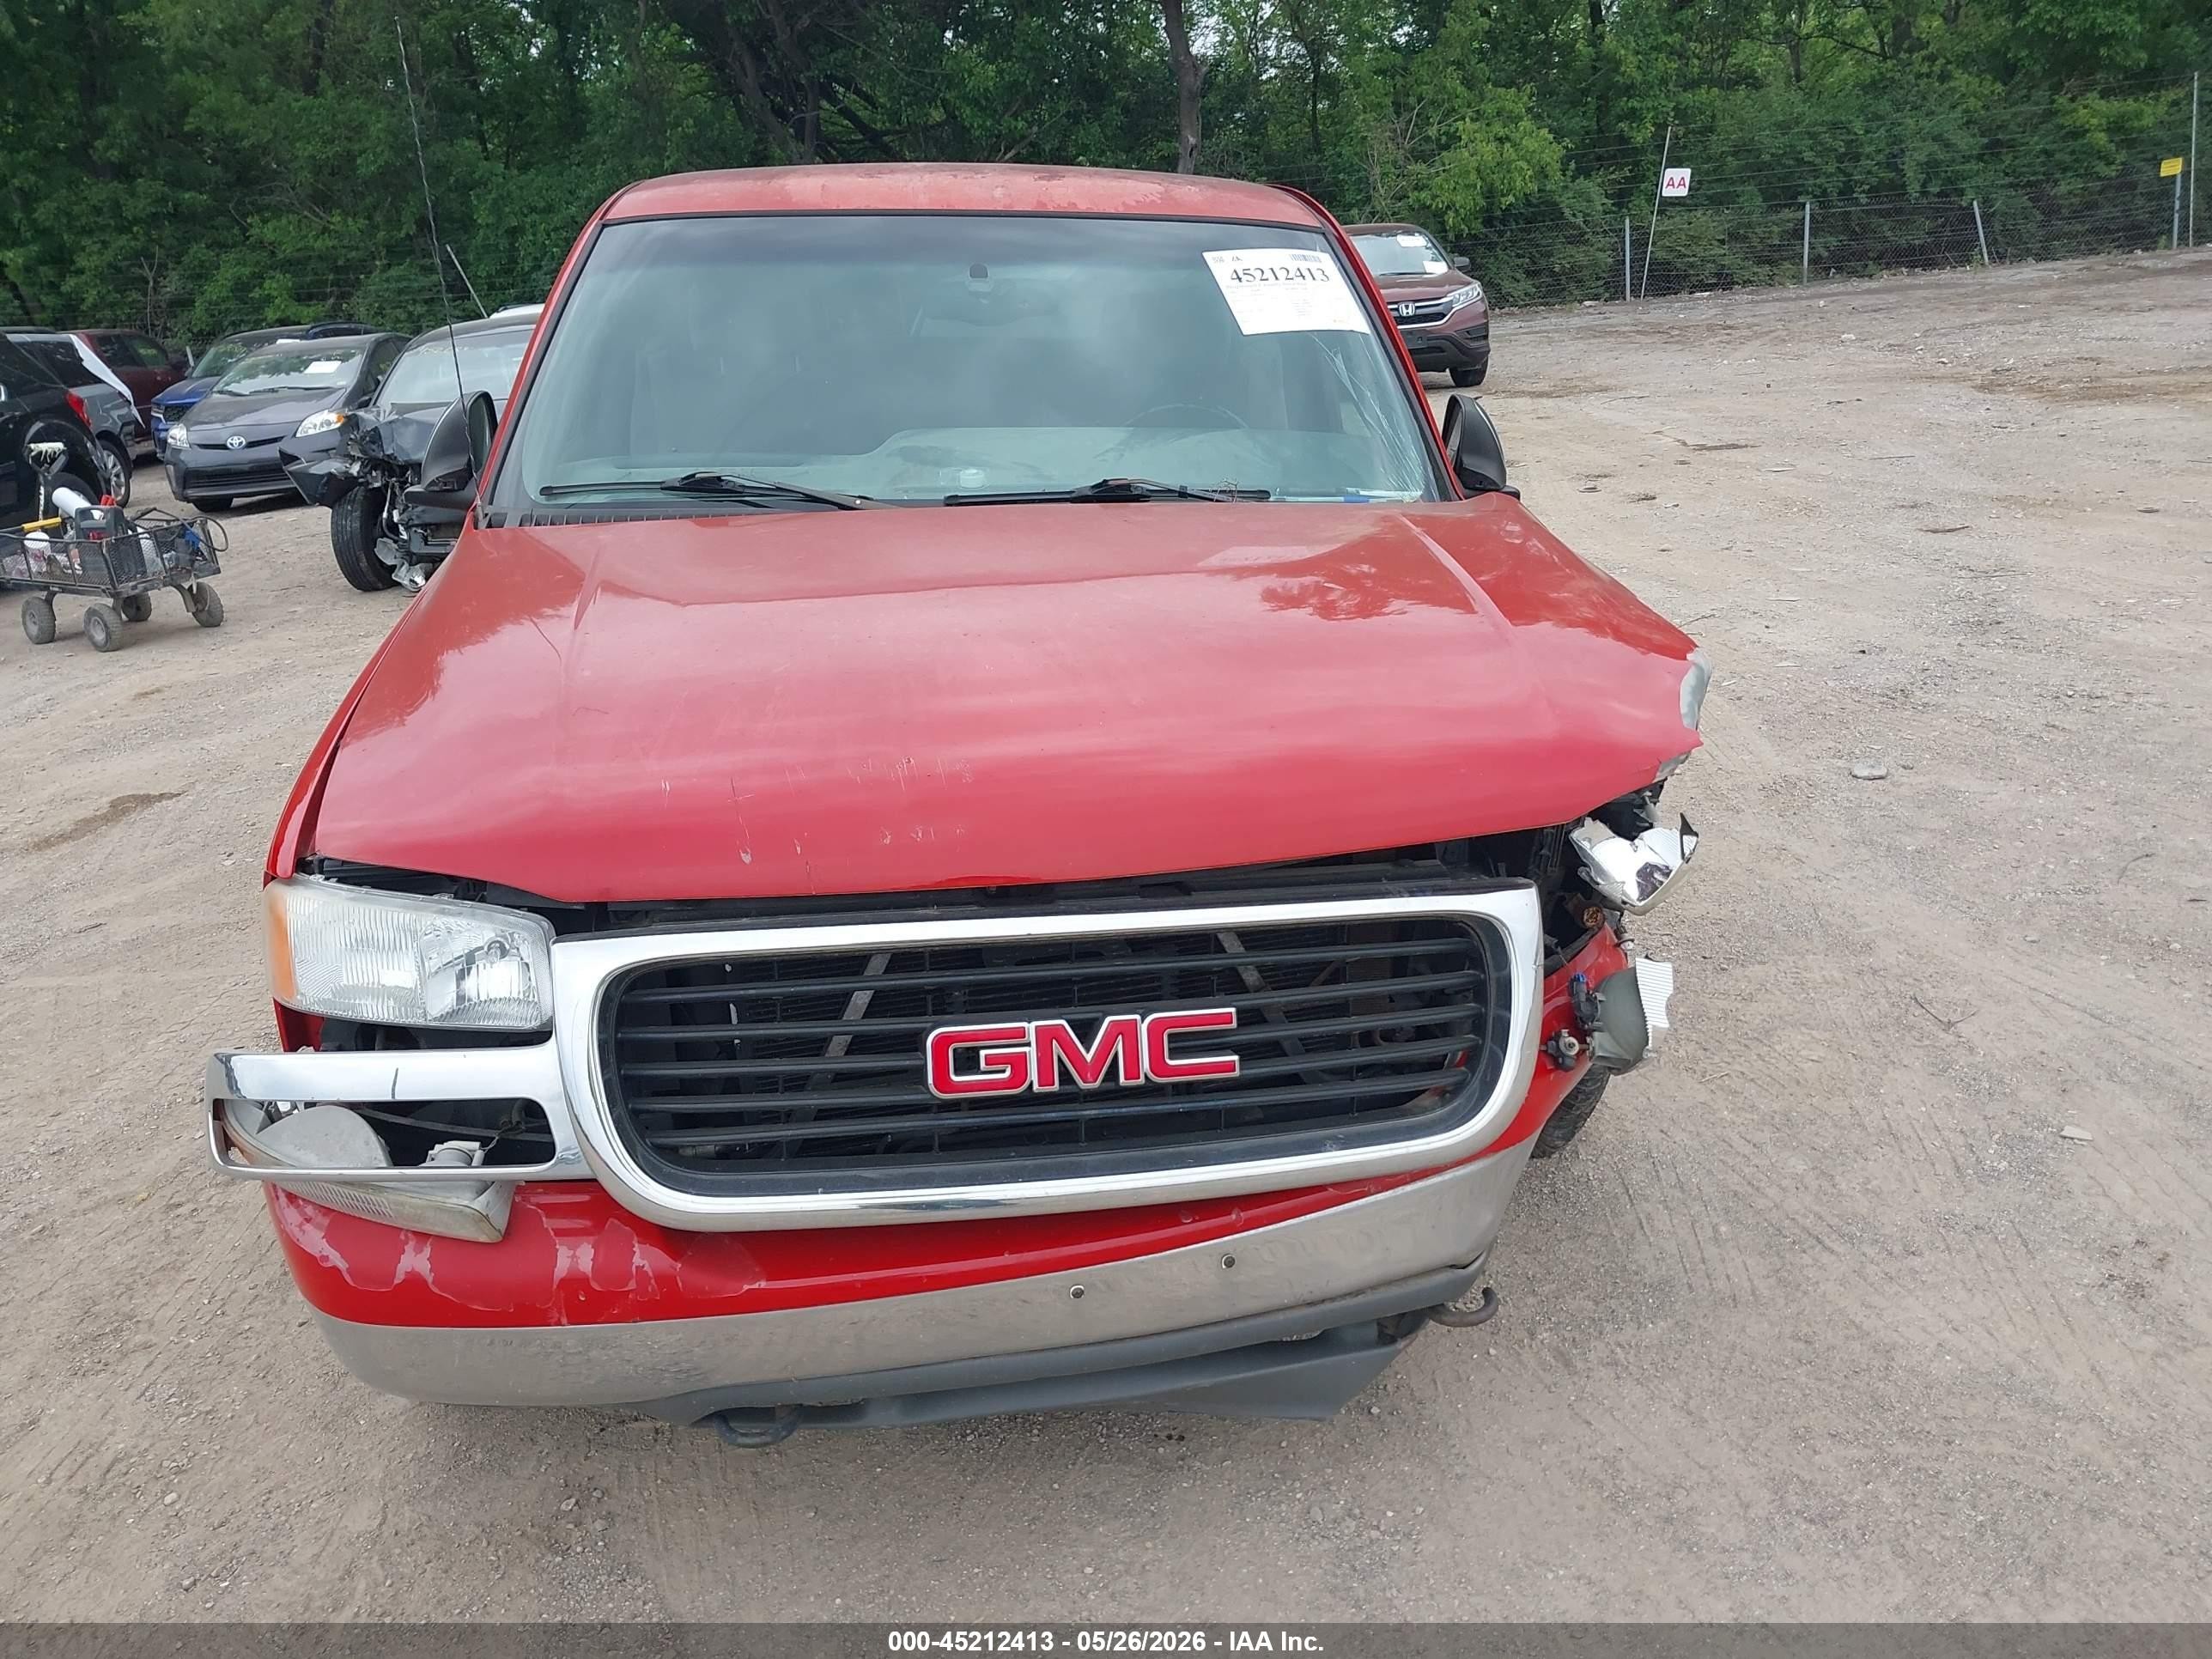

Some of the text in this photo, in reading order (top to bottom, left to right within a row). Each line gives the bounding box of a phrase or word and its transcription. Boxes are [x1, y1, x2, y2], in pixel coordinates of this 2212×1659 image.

[1665, 176, 1686, 189] AA
[1230, 266, 1330, 283] 45212413
[927, 1007, 1240, 1099] GMC
